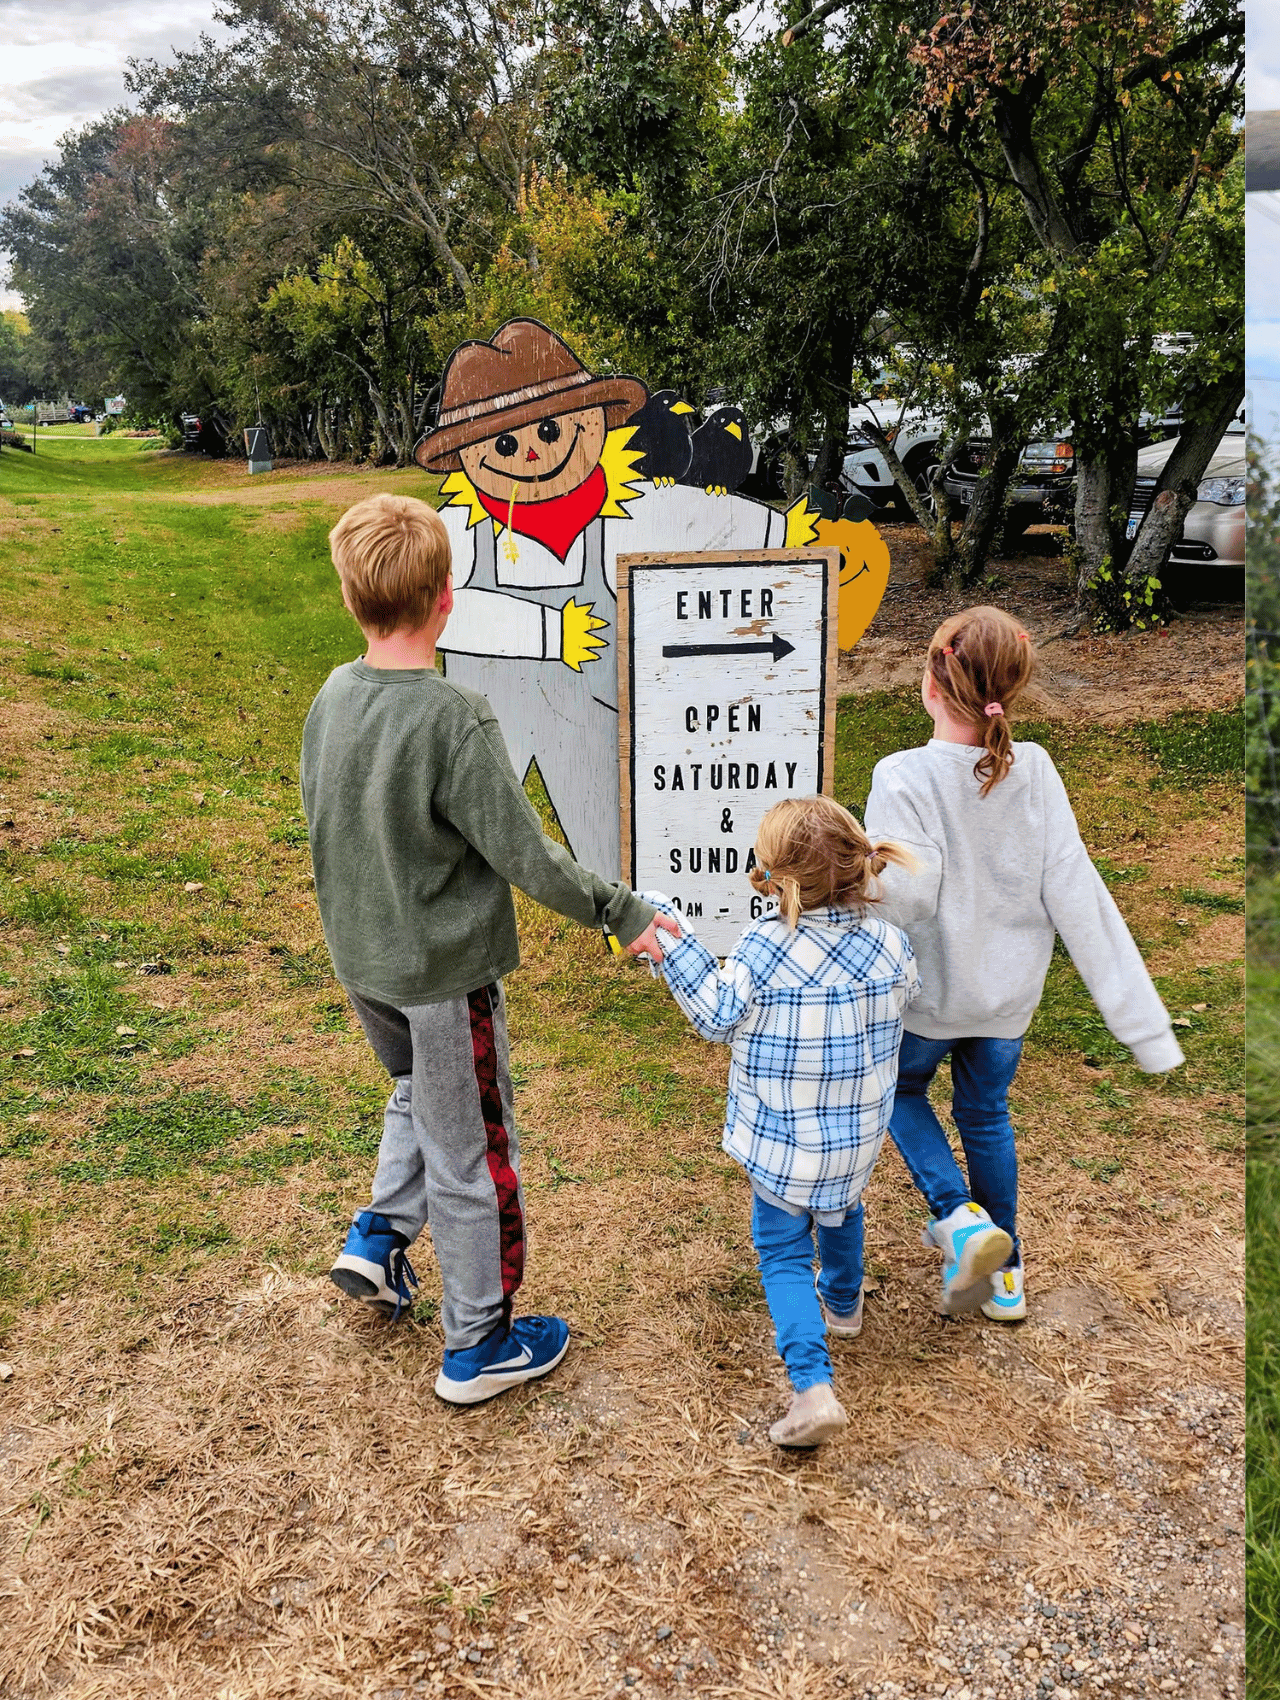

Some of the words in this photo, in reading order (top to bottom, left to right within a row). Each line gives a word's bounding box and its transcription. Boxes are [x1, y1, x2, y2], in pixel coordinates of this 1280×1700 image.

[676, 588, 775, 620] ENTER
[685, 704, 761, 733] OPEN
[653, 762, 798, 791] SATURDAY
[720, 807, 734, 833] &
[669, 847, 757, 873] SUNDA
[750, 895, 780, 920] 6P
